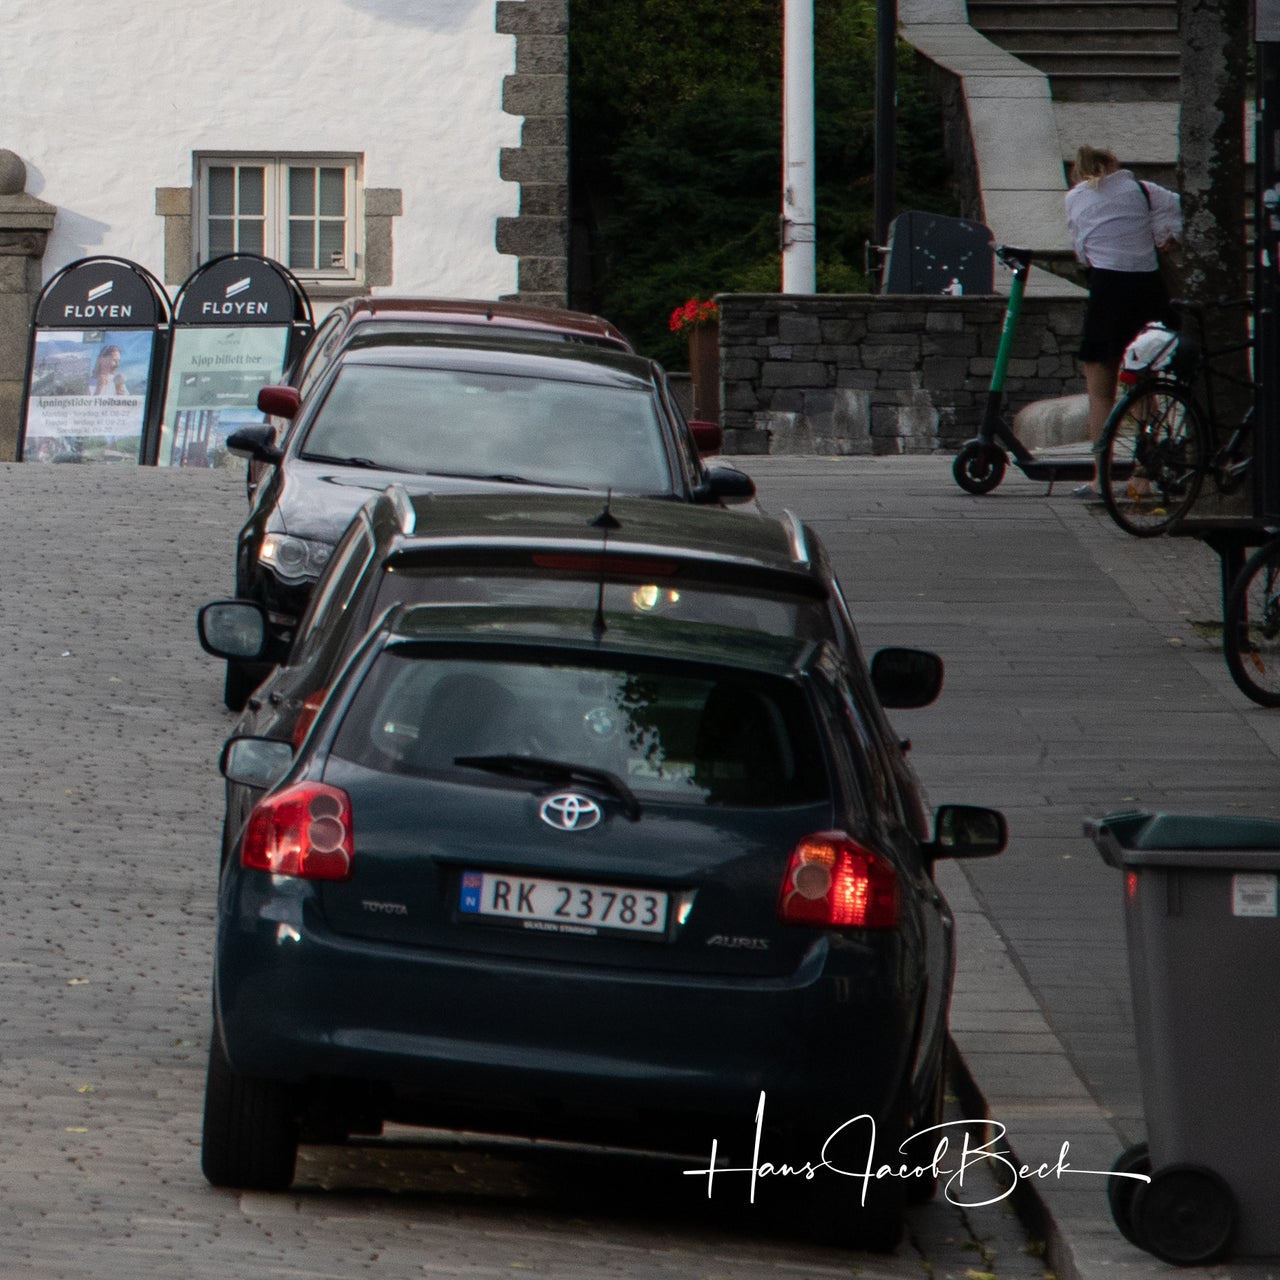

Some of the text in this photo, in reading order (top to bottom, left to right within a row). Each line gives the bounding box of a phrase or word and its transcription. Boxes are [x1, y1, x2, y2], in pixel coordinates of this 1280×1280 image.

[64, 305, 132, 318] FLØYEN
[202, 302, 269, 314] FLØYEN
[362, 900, 408, 916] TOYOTA
[465, 896, 476, 907] N
[492, 880, 659, 926] RK 23783
[706, 933, 770, 951] AURIS
